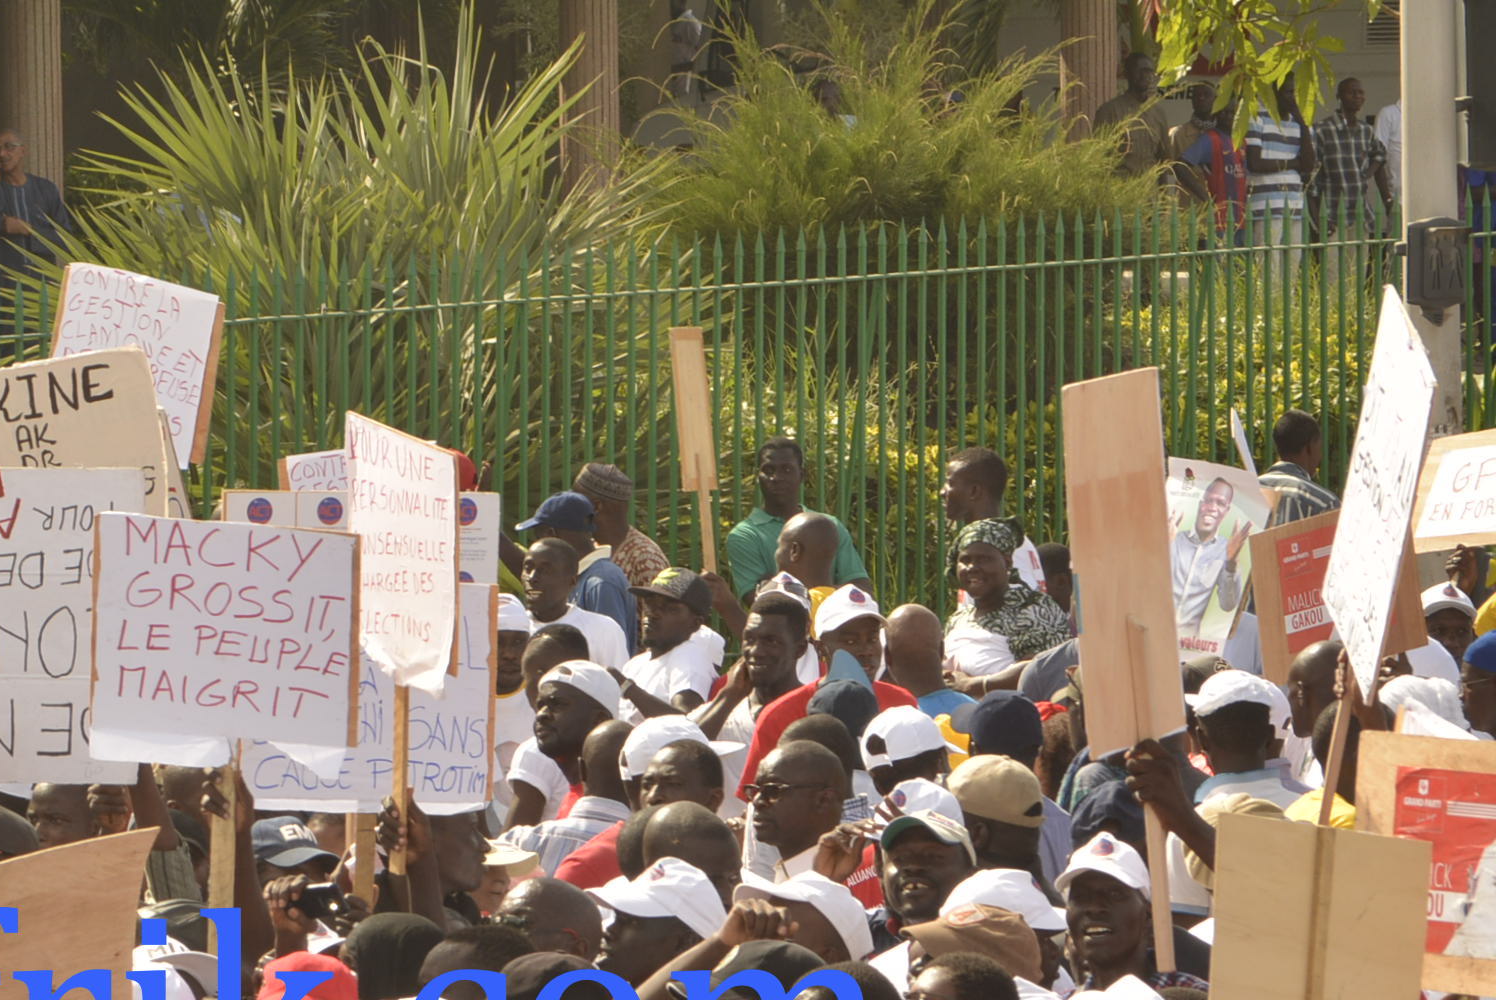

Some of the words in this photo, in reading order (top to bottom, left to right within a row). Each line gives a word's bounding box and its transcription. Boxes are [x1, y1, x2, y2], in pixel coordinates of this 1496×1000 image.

[68, 294, 170, 341] GESTION
[71, 266, 154, 305] CONTRE
[157, 287, 182, 323] LA
[15, 423, 56, 452] AK
[349, 421, 392, 468] POUR
[395, 446, 434, 481] UNE
[33, 503, 104, 532] OUR
[60, 549, 94, 585] E
[125, 516, 323, 582] MACKY
[360, 611, 432, 643] LECTIONS
[1291, 607, 1324, 630] GAKOU
[117, 620, 170, 651] LE
[194, 625, 349, 677] PEUPLE
[117, 666, 329, 719] MAIGRIT
